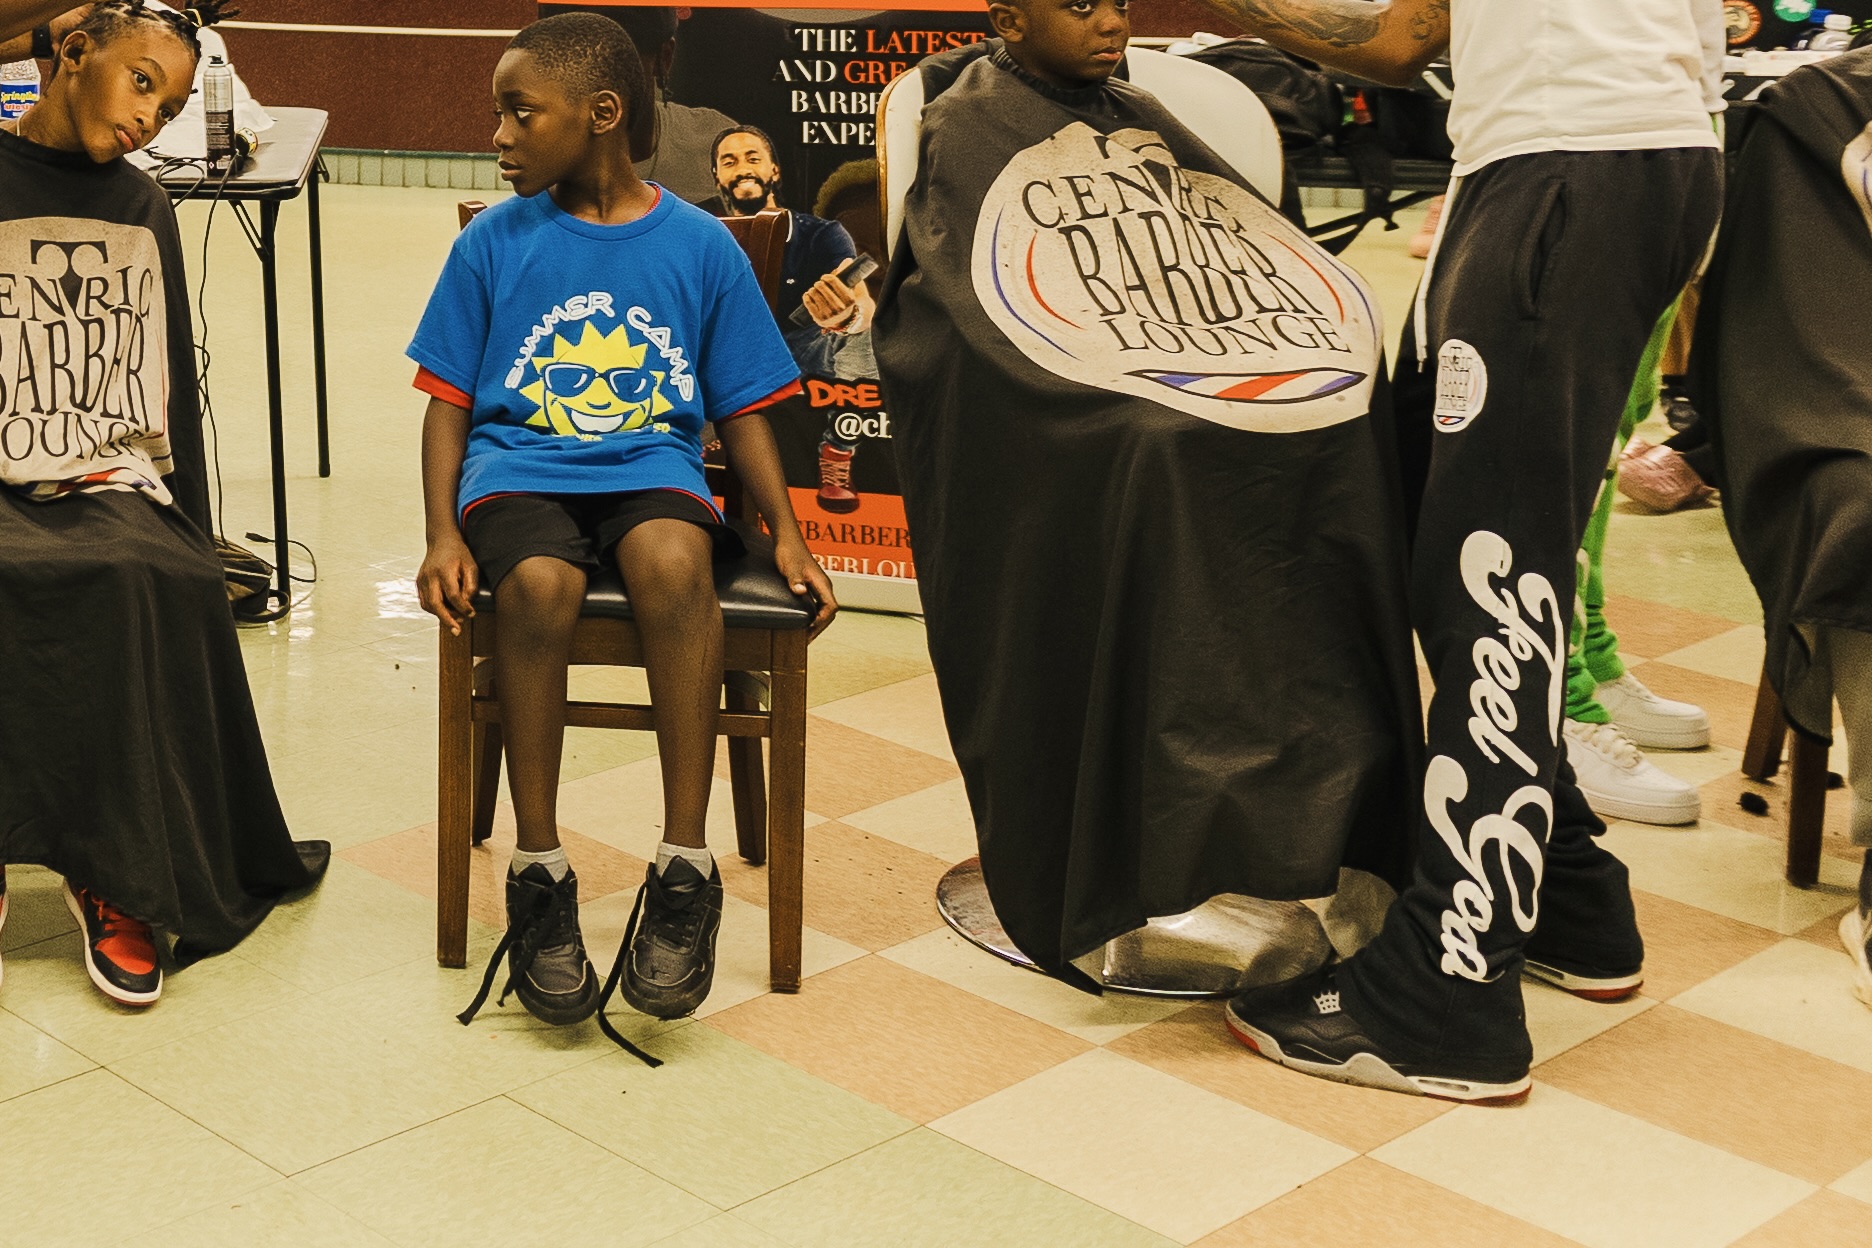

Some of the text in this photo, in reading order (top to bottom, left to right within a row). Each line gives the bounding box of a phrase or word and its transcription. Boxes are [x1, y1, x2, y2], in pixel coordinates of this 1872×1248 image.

[795, 29, 857, 52] THE
[772, 59, 907, 85] AND GRE
[802, 121, 875, 145] EXPE
[1057, 208, 1324, 327] BARBER
[504, 290, 695, 402] SUMMER CAMP
[1098, 314, 1353, 357] LOUNGE
[834, 412, 892, 440] @ch
[1459, 529, 1566, 777] Feel
